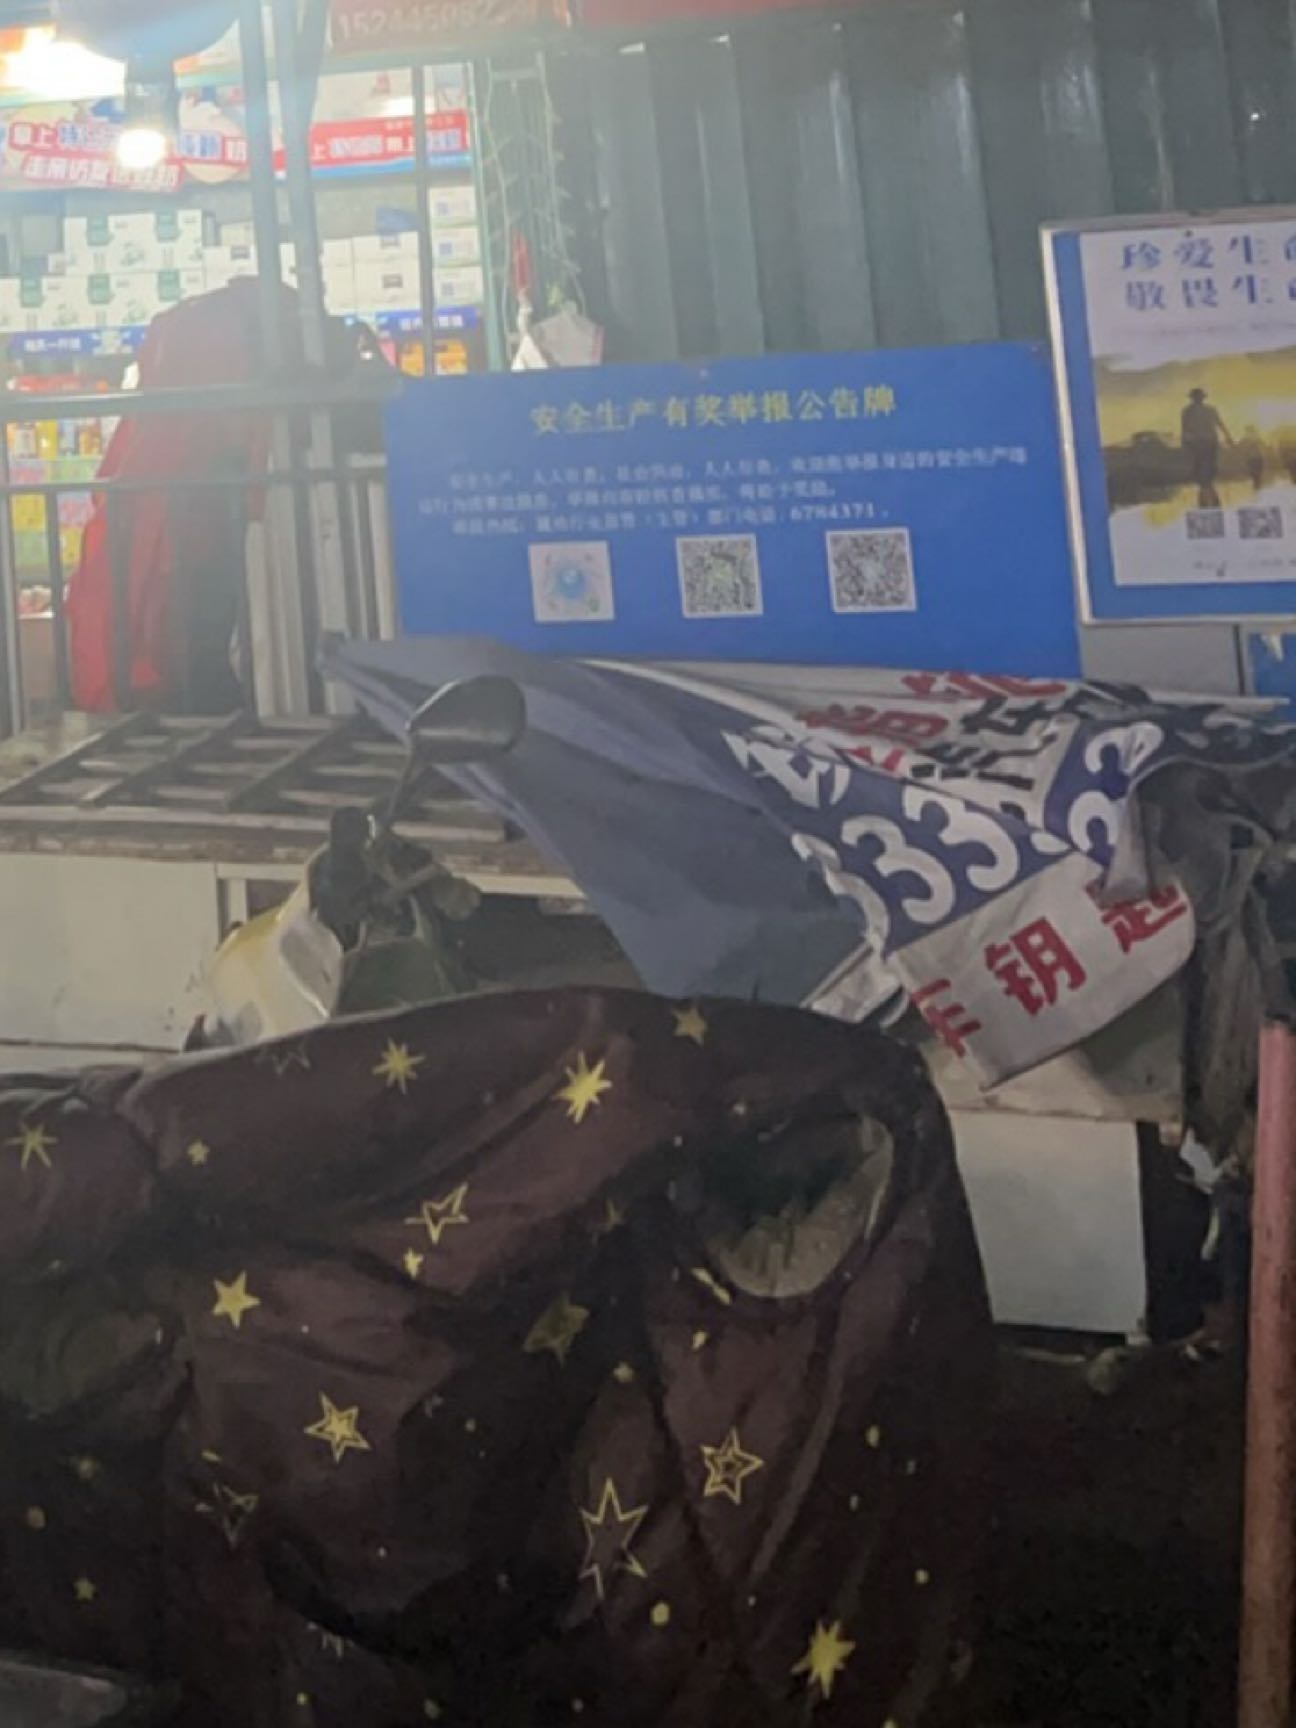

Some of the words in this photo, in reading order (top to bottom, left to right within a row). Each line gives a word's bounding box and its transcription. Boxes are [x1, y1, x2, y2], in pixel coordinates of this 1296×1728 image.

[529, 384, 897, 436] 安全生产有奖举报公告牌
